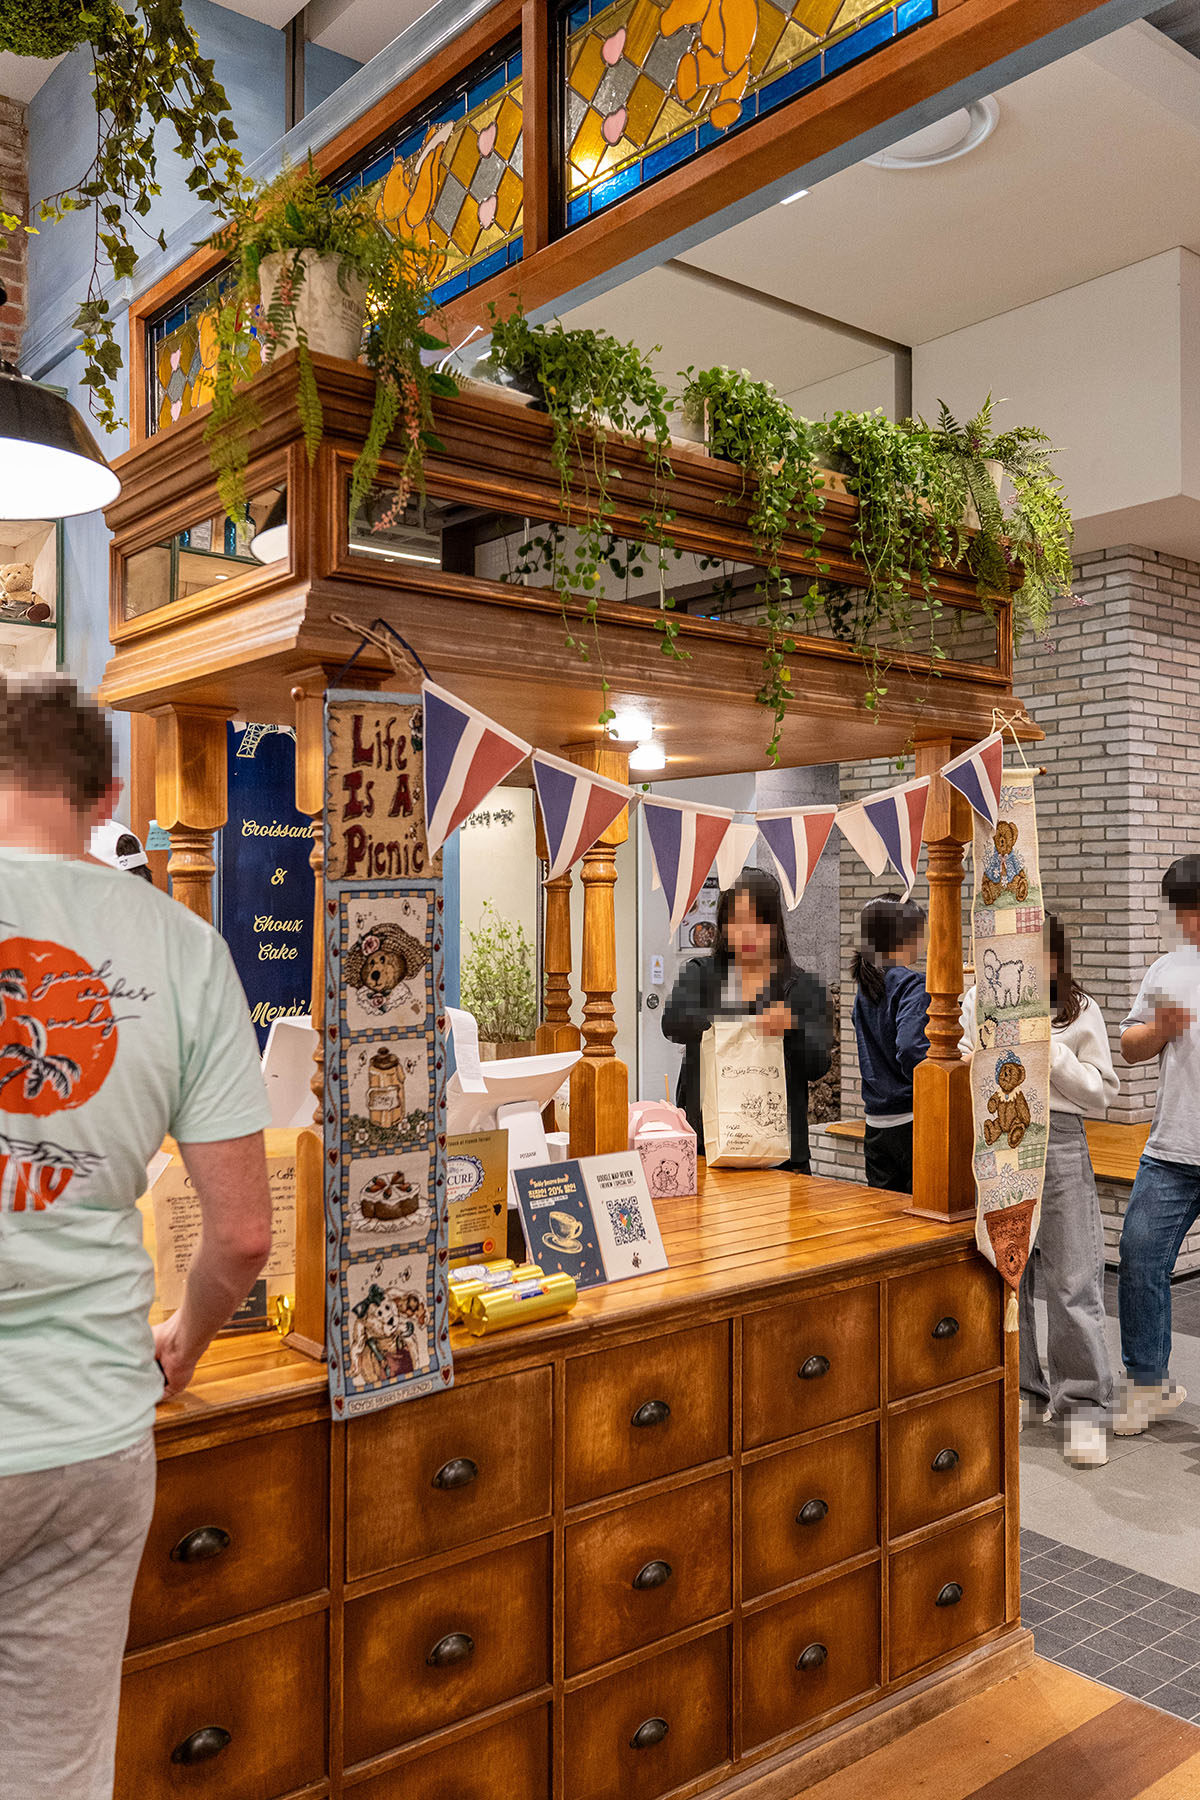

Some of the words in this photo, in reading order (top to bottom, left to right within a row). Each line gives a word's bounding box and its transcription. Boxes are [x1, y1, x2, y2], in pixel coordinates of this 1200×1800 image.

[351, 714, 408, 771] Life
[342, 770, 375, 822] Is
[388, 773, 414, 818] A
[343, 824, 425, 878] Picnic
[270, 867, 289, 886] &
[253, 914, 304, 934] Choux
[257, 941, 299, 961] Cake
[32, 960, 112, 1001] good
[77, 978, 156, 1002] vibes
[46, 1002, 142, 1039] only
[447, 1172, 474, 1186] CURE
[596, 1173, 611, 1182] GOOGLE
[611, 1171, 620, 1180] MAP
[619, 1169, 633, 1179] REVIEW
[547, 1185, 564, 1196] 20%
